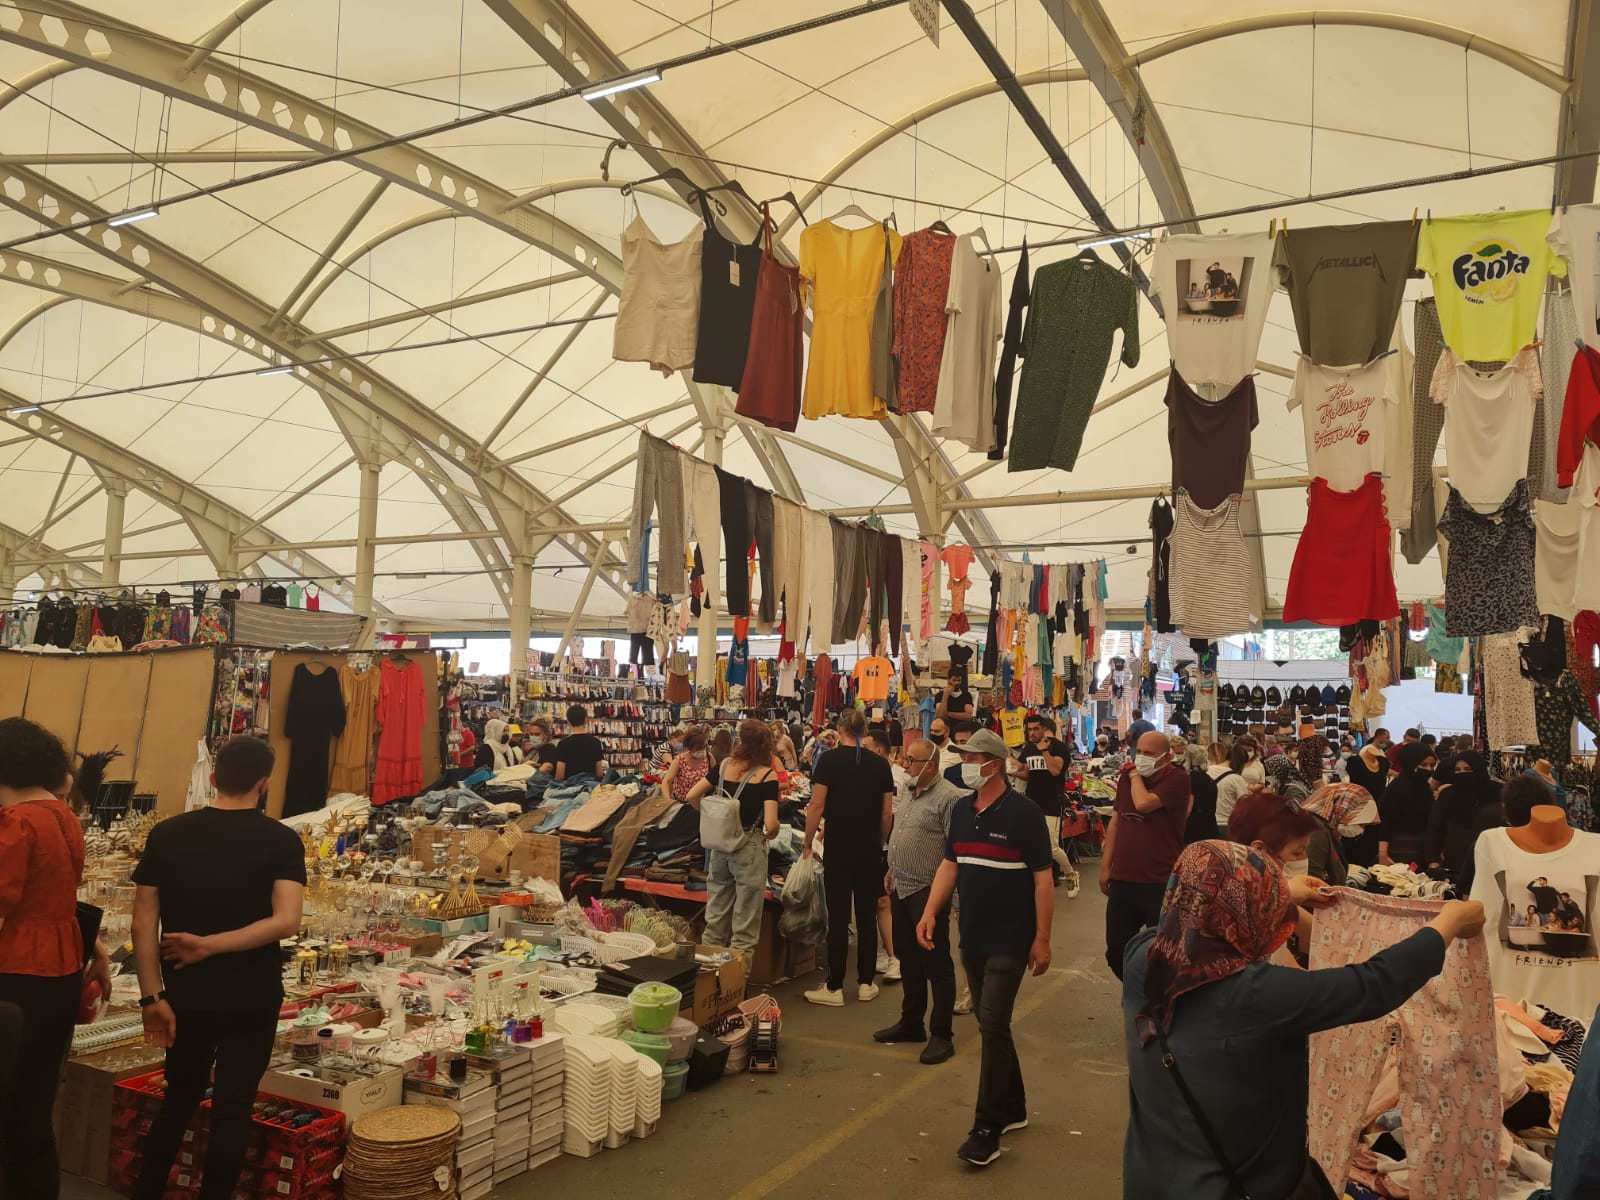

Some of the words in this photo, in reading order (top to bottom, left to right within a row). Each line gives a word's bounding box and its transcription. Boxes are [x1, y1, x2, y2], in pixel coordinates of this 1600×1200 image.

[1453, 250, 1530, 290] Fanta
[1325, 382, 1354, 401] The
[1316, 396, 1375, 428] Rolling
[1314, 423, 1362, 452] Stones
[1515, 955, 1572, 967] FRIENDS
